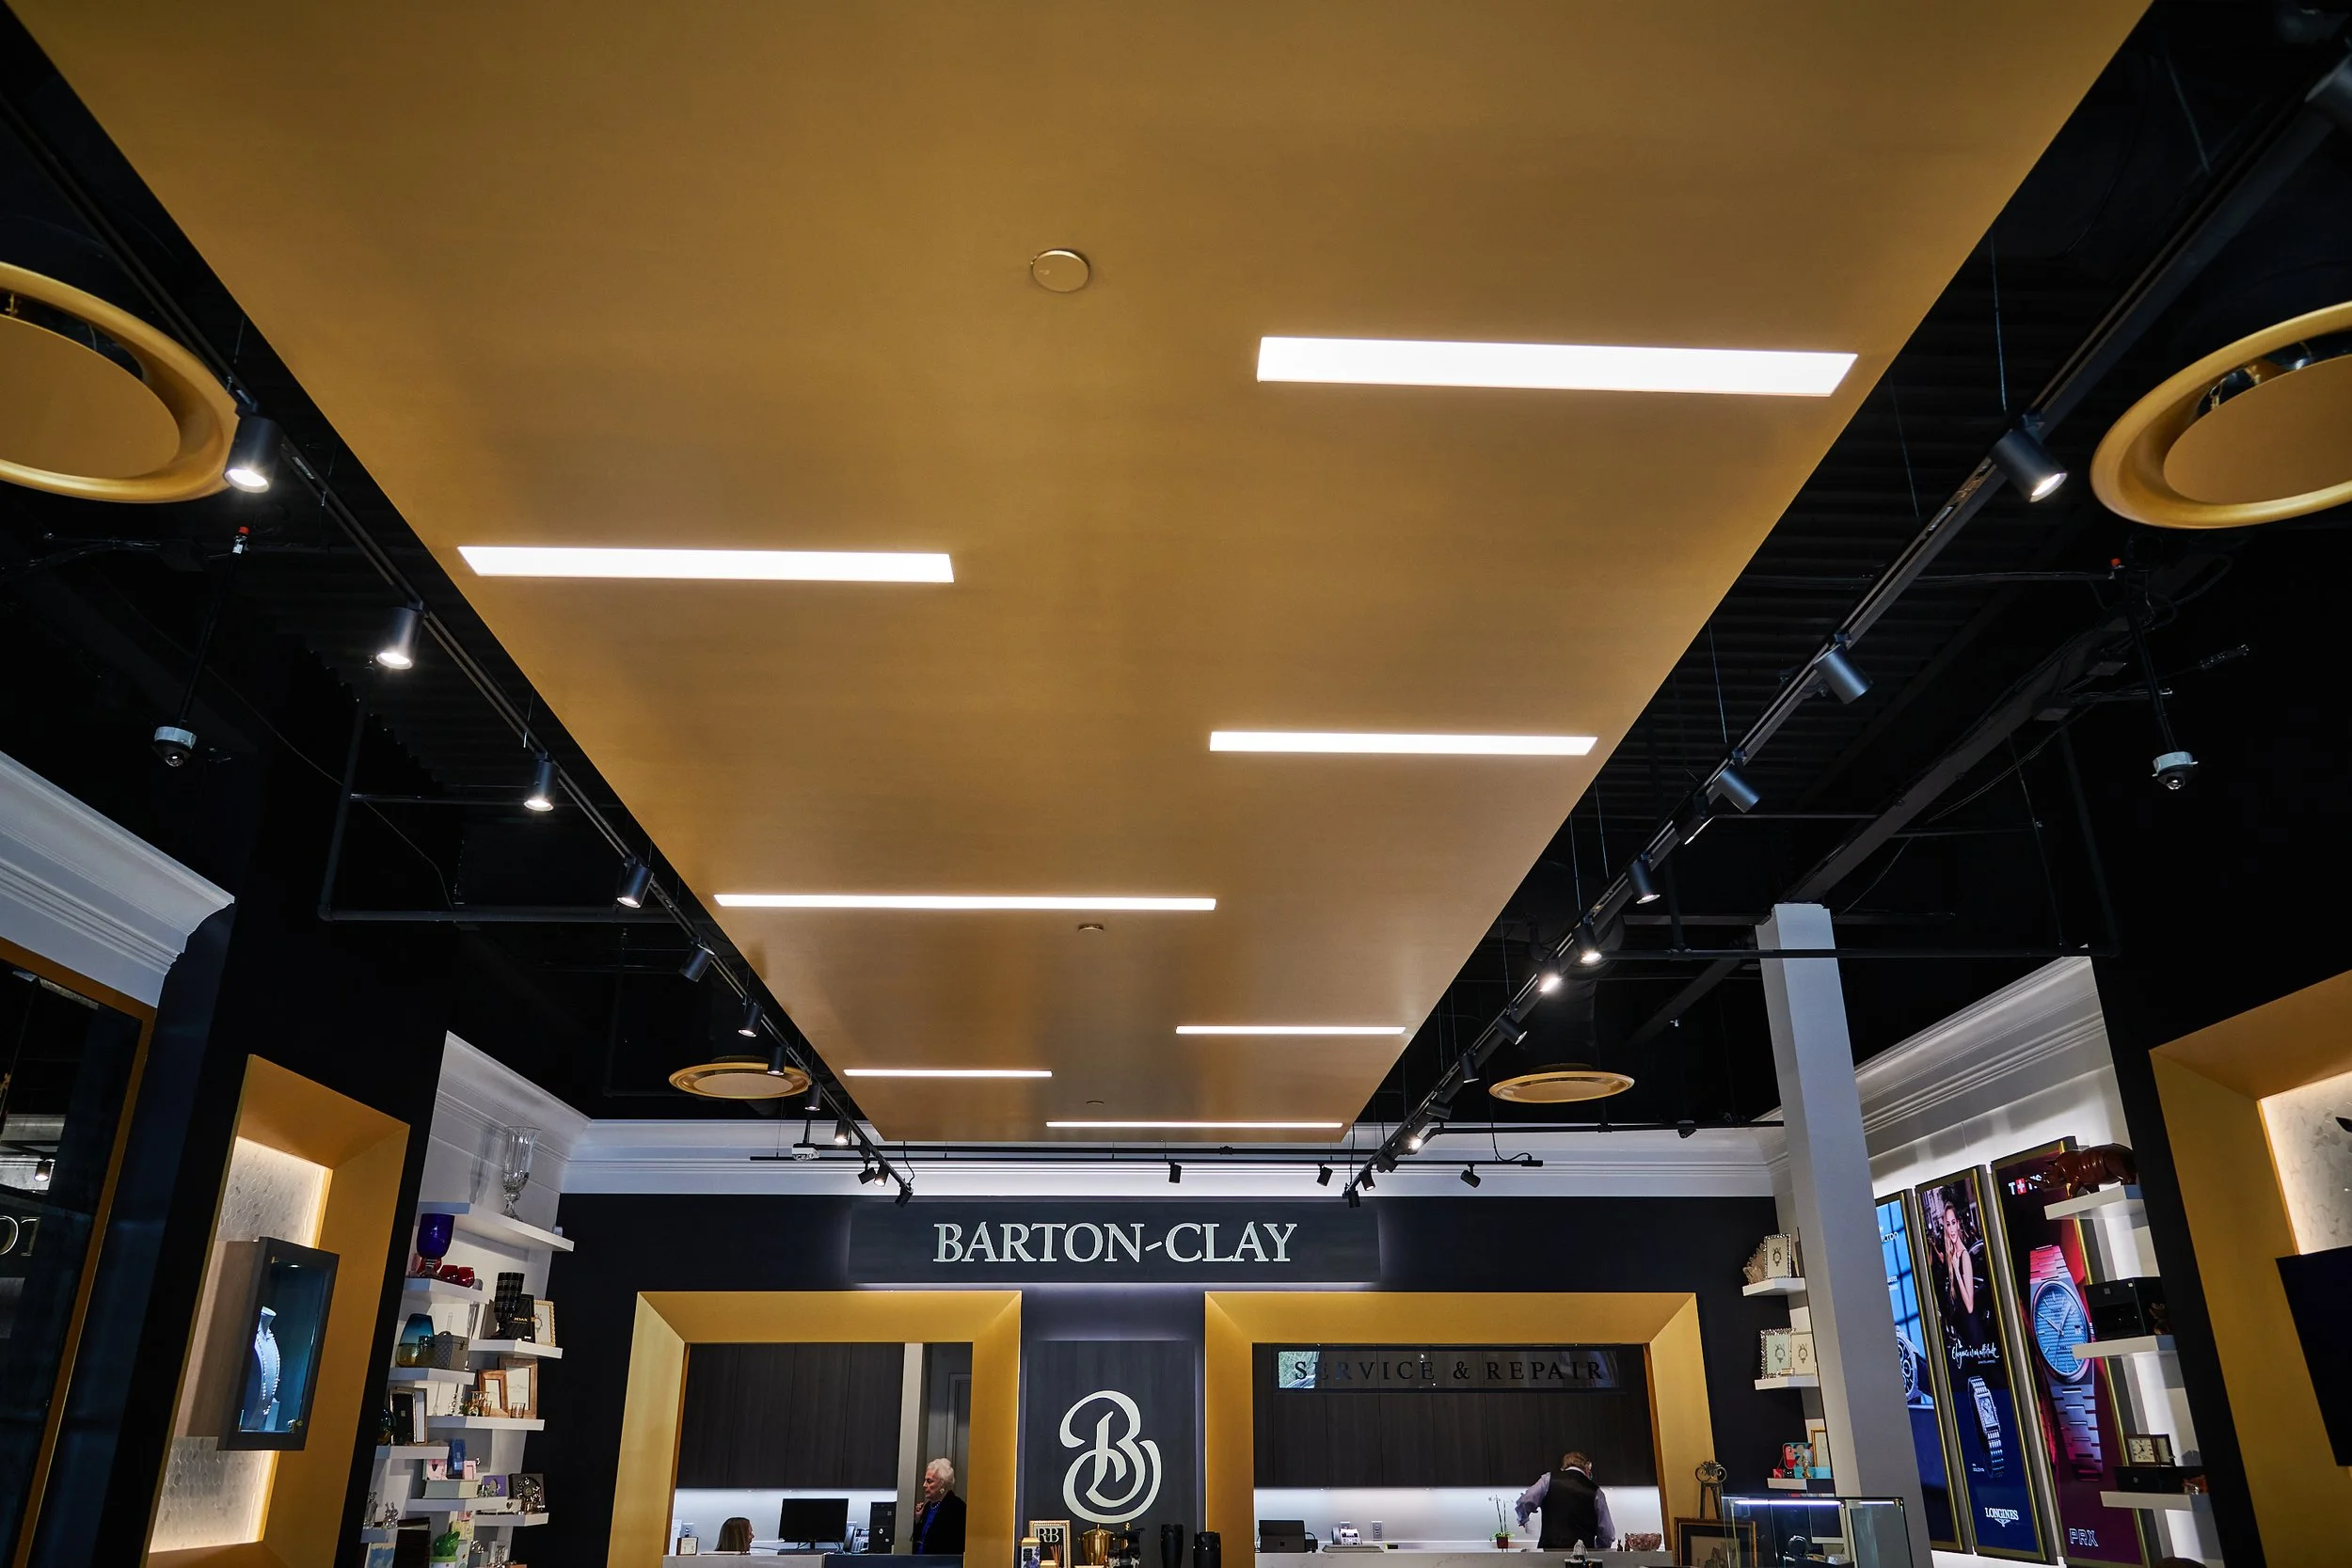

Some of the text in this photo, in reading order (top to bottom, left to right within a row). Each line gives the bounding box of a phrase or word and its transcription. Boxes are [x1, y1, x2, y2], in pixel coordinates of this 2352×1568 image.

[932, 1221, 1297, 1262] BARTON-CLAY
[1294, 1360, 1604, 1380] SERVICE & REPAIR
[1984, 1507, 2019, 1521] LONGINES
[2069, 1528, 2099, 1547] PRX
